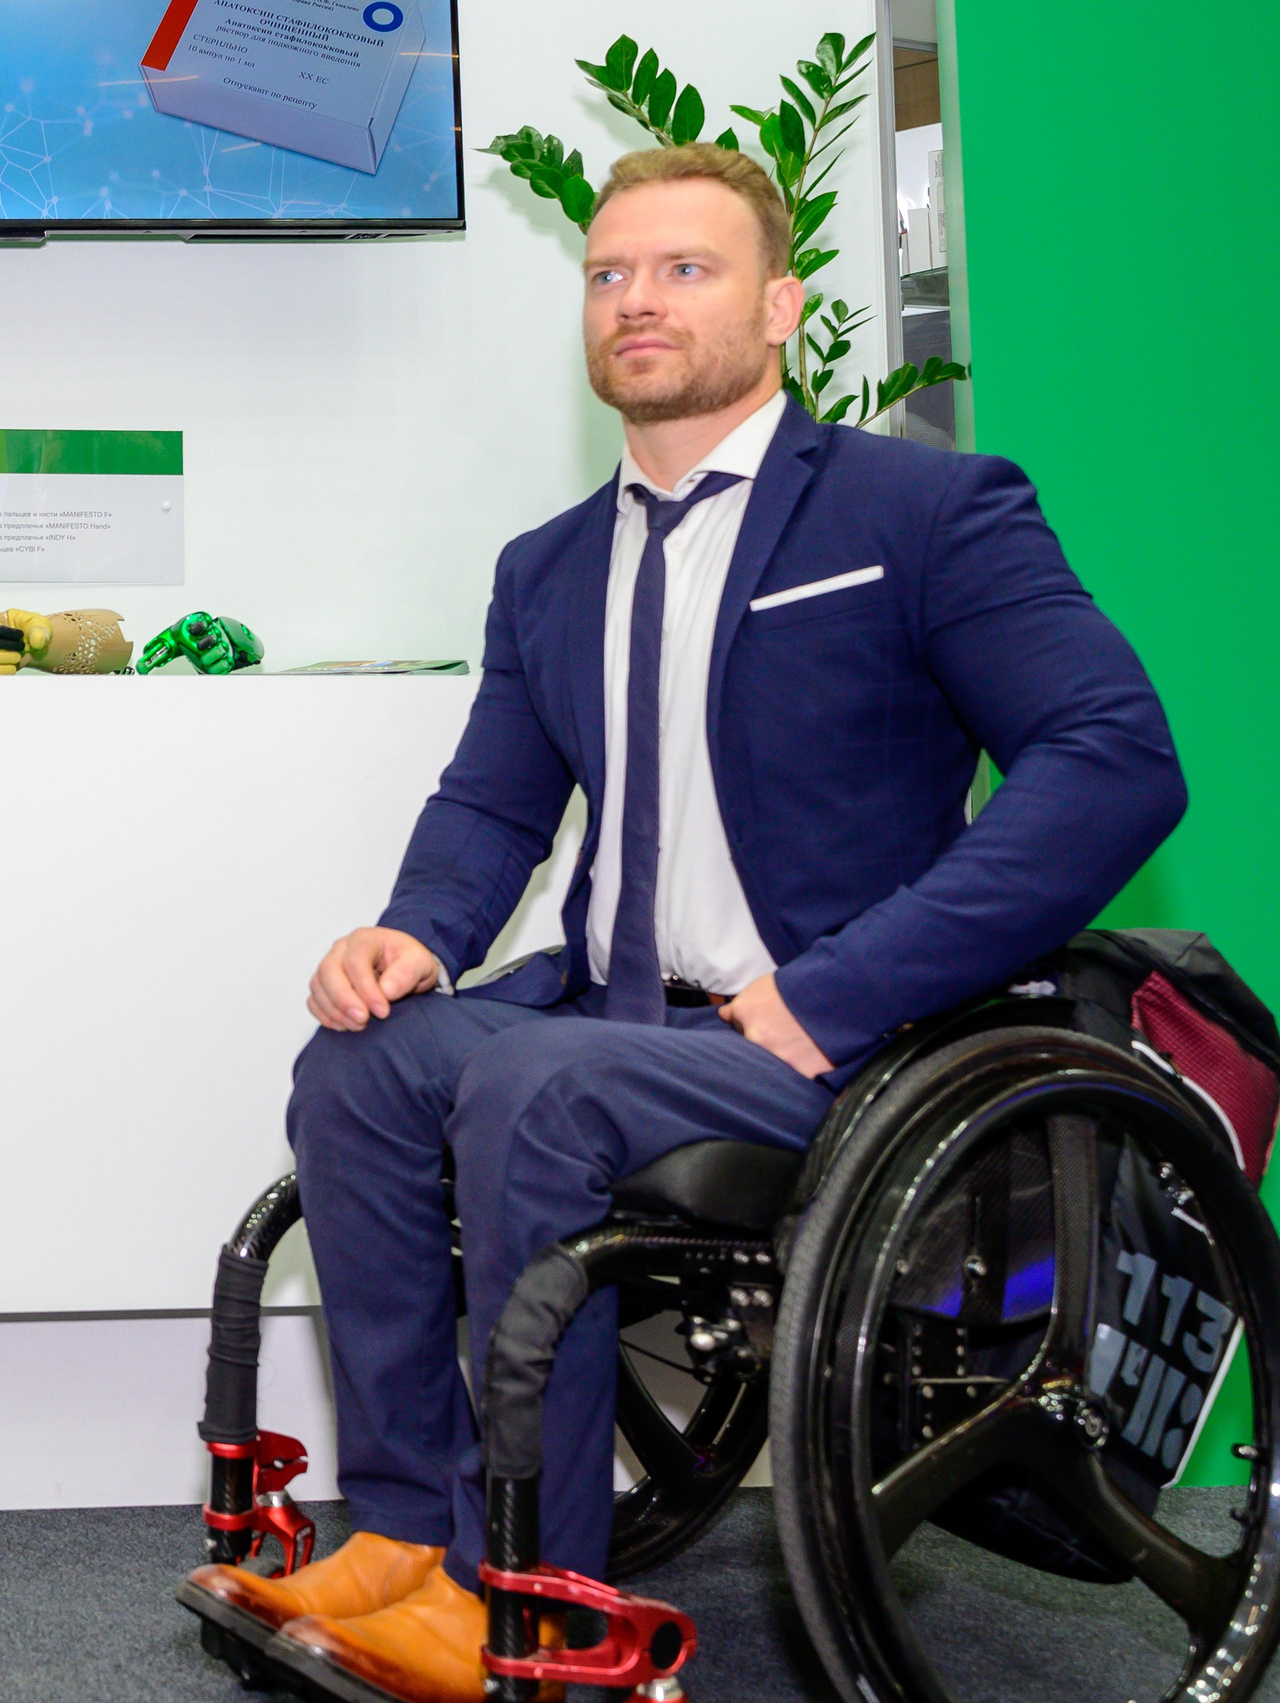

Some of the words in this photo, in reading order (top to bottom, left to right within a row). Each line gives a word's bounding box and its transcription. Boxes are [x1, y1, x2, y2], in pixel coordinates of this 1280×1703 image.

[192, 33, 249, 54] СТЕРИЛЬНО
[224, 18, 273, 36] Анатоксин
[274, 32, 360, 59] стафилококковый
[259, 18, 330, 42] ОЧИЩЕННЫЙ
[276, 14, 385, 48] СТАФИЛОКОККОВЫЙ
[187, 44, 198, 52] 10
[198, 48, 224, 60] ампул
[224, 55, 236, 63] по
[215, 25, 250, 39] раствор
[250, 35, 266, 43] для
[267, 38, 320, 57] подкожного
[320, 53, 362, 69] введения
[223, 76, 270, 95] Отпускают
[270, 91, 282, 99] по
[282, 95, 318, 110] рецепту
[45, 522, 89, 530] «MANIFESTO
